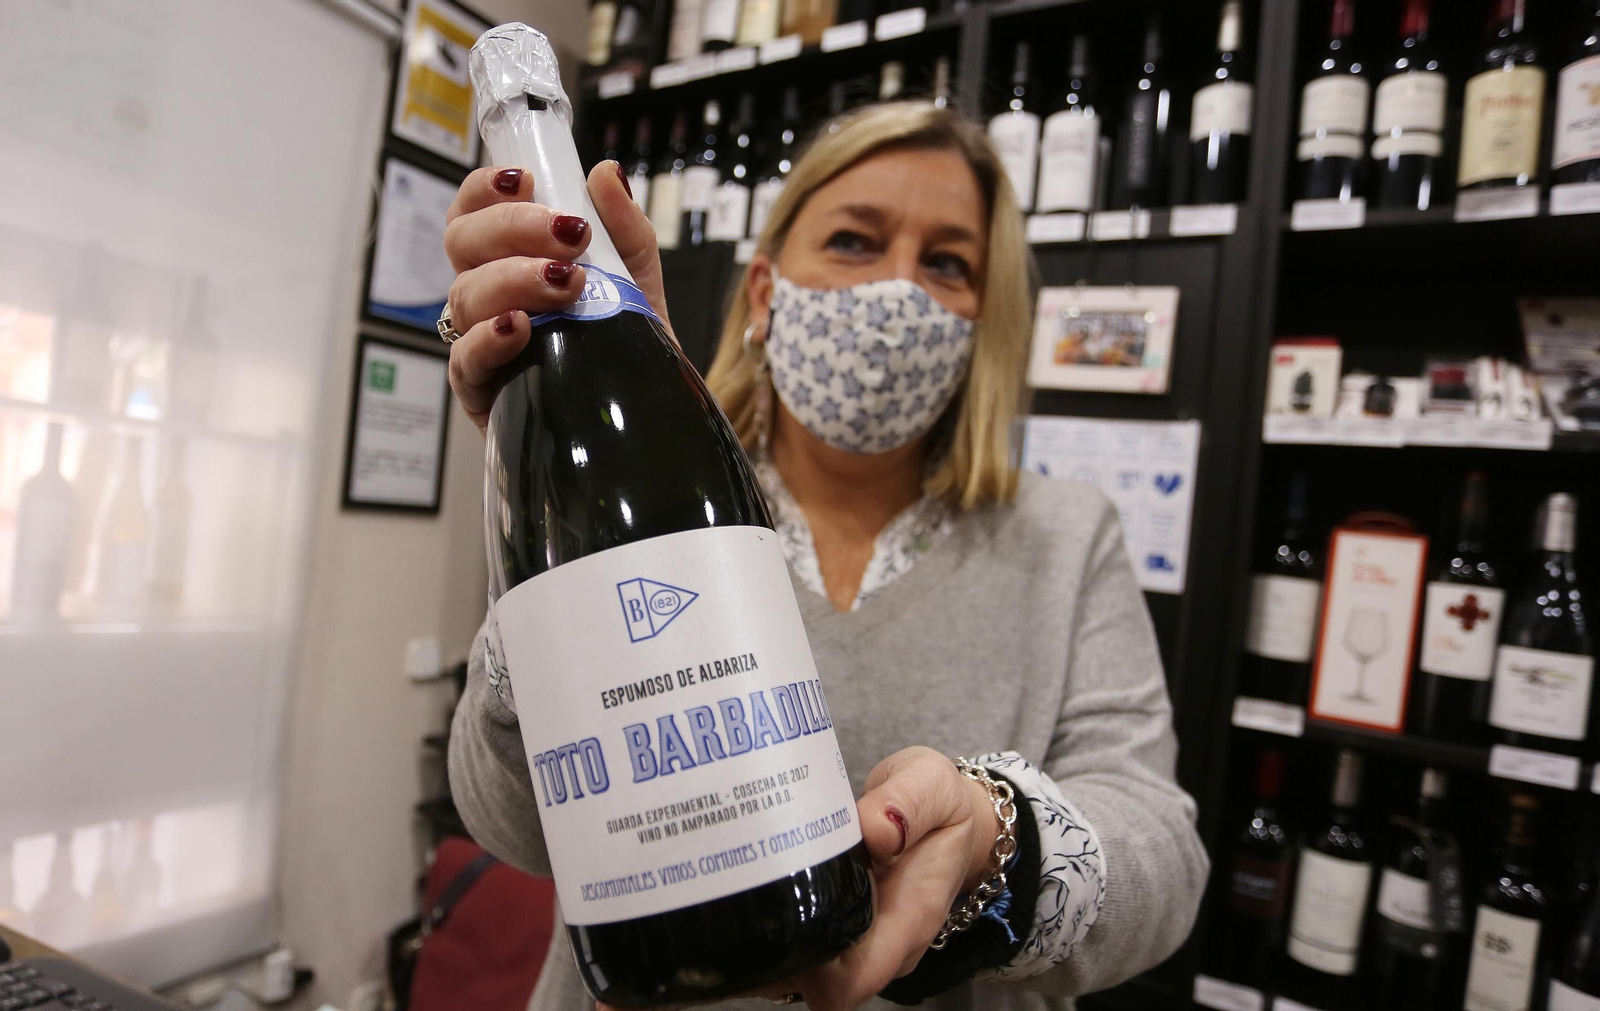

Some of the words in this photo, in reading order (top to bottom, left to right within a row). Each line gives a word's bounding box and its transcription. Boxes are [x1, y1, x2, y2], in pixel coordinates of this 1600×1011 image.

[627, 598, 644, 623] B
[653, 595, 677, 610] 1821
[601, 673, 674, 710] ESPUMOSO
[676, 667, 696, 688] DE
[699, 653, 759, 682] ALBARIZA
[533, 737, 610, 807] TOTO
[606, 813, 643, 835] GUARDA
[645, 792, 723, 825] EXPERIMENTAL
[732, 776, 777, 801] COSECHA
[777, 772, 789, 787] DE
[789, 764, 810, 782] 2017
[637, 826, 662, 844] VINO
[663, 822, 679, 838] NO
[681, 805, 738, 833] AMPARADO
[739, 800, 760, 817] POR
[761, 795, 775, 810] LA
[581, 871, 657, 902] DESCOMUNALES
[657, 861, 698, 886] VINOS
[698, 843, 757, 876] COMUNES
[757, 840, 768, 858] Y
[768, 827, 805, 854] OTRAS
[804, 817, 832, 841] COSAS
